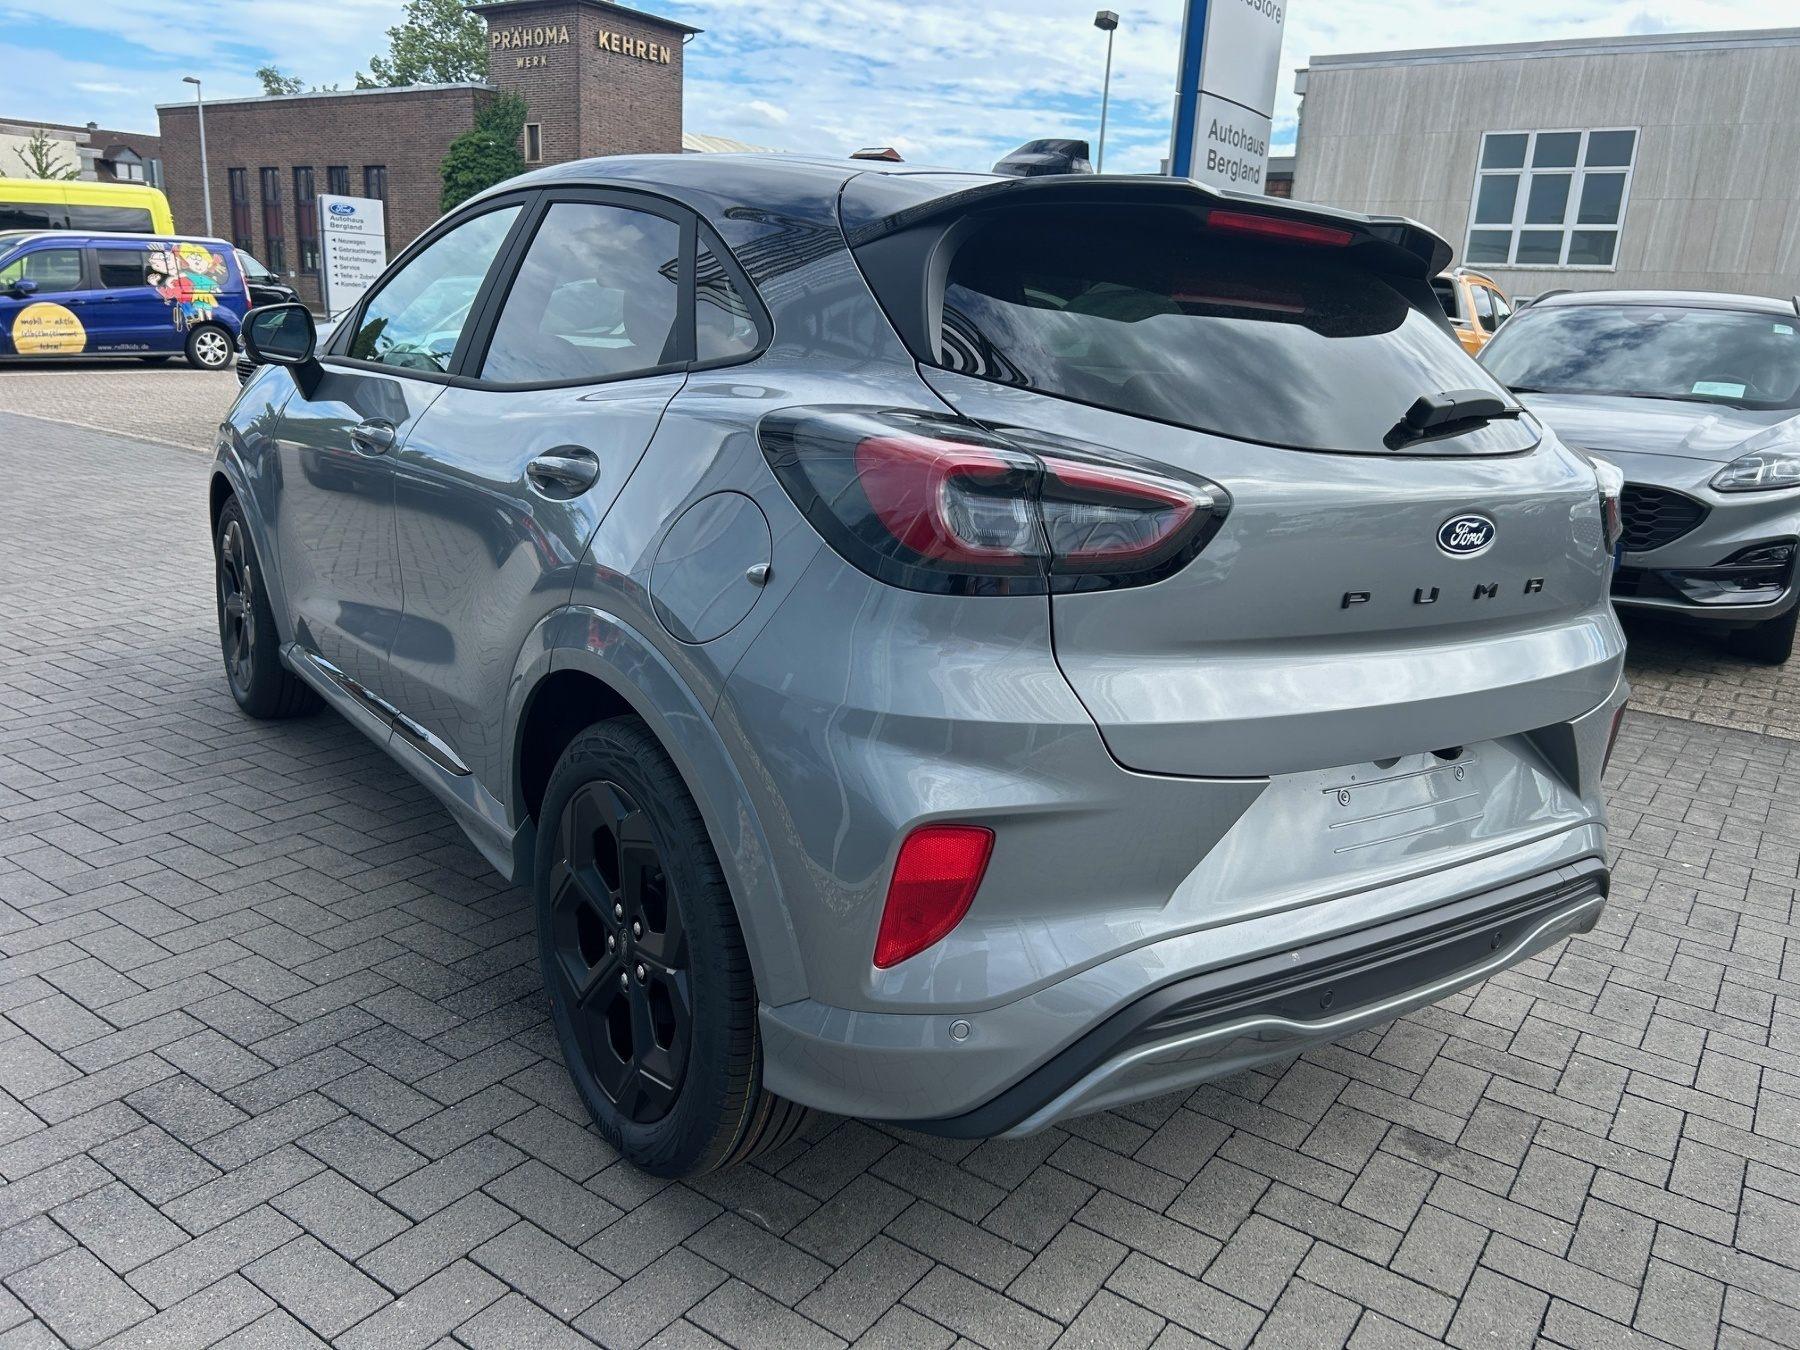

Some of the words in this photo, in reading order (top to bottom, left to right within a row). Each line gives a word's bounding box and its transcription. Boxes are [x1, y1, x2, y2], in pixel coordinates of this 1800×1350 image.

[491, 25, 570, 49] PRÄHOMA
[599, 30, 671, 65] KEHREN
[516, 55, 548, 70] WERK
[1208, 118, 1264, 157] Autohaus
[1207, 148, 1261, 184] Bergland
[330, 215, 364, 224] Autohaus
[330, 222, 362, 231] Bergland
[338, 238, 366, 246] Neuwagen
[338, 247, 382, 256] Gebrauchtwagen
[339, 256, 377, 264] Nutzfahrzeuge
[1450, 521, 1487, 546] Ford
[1341, 577, 1544, 609] PUMA
